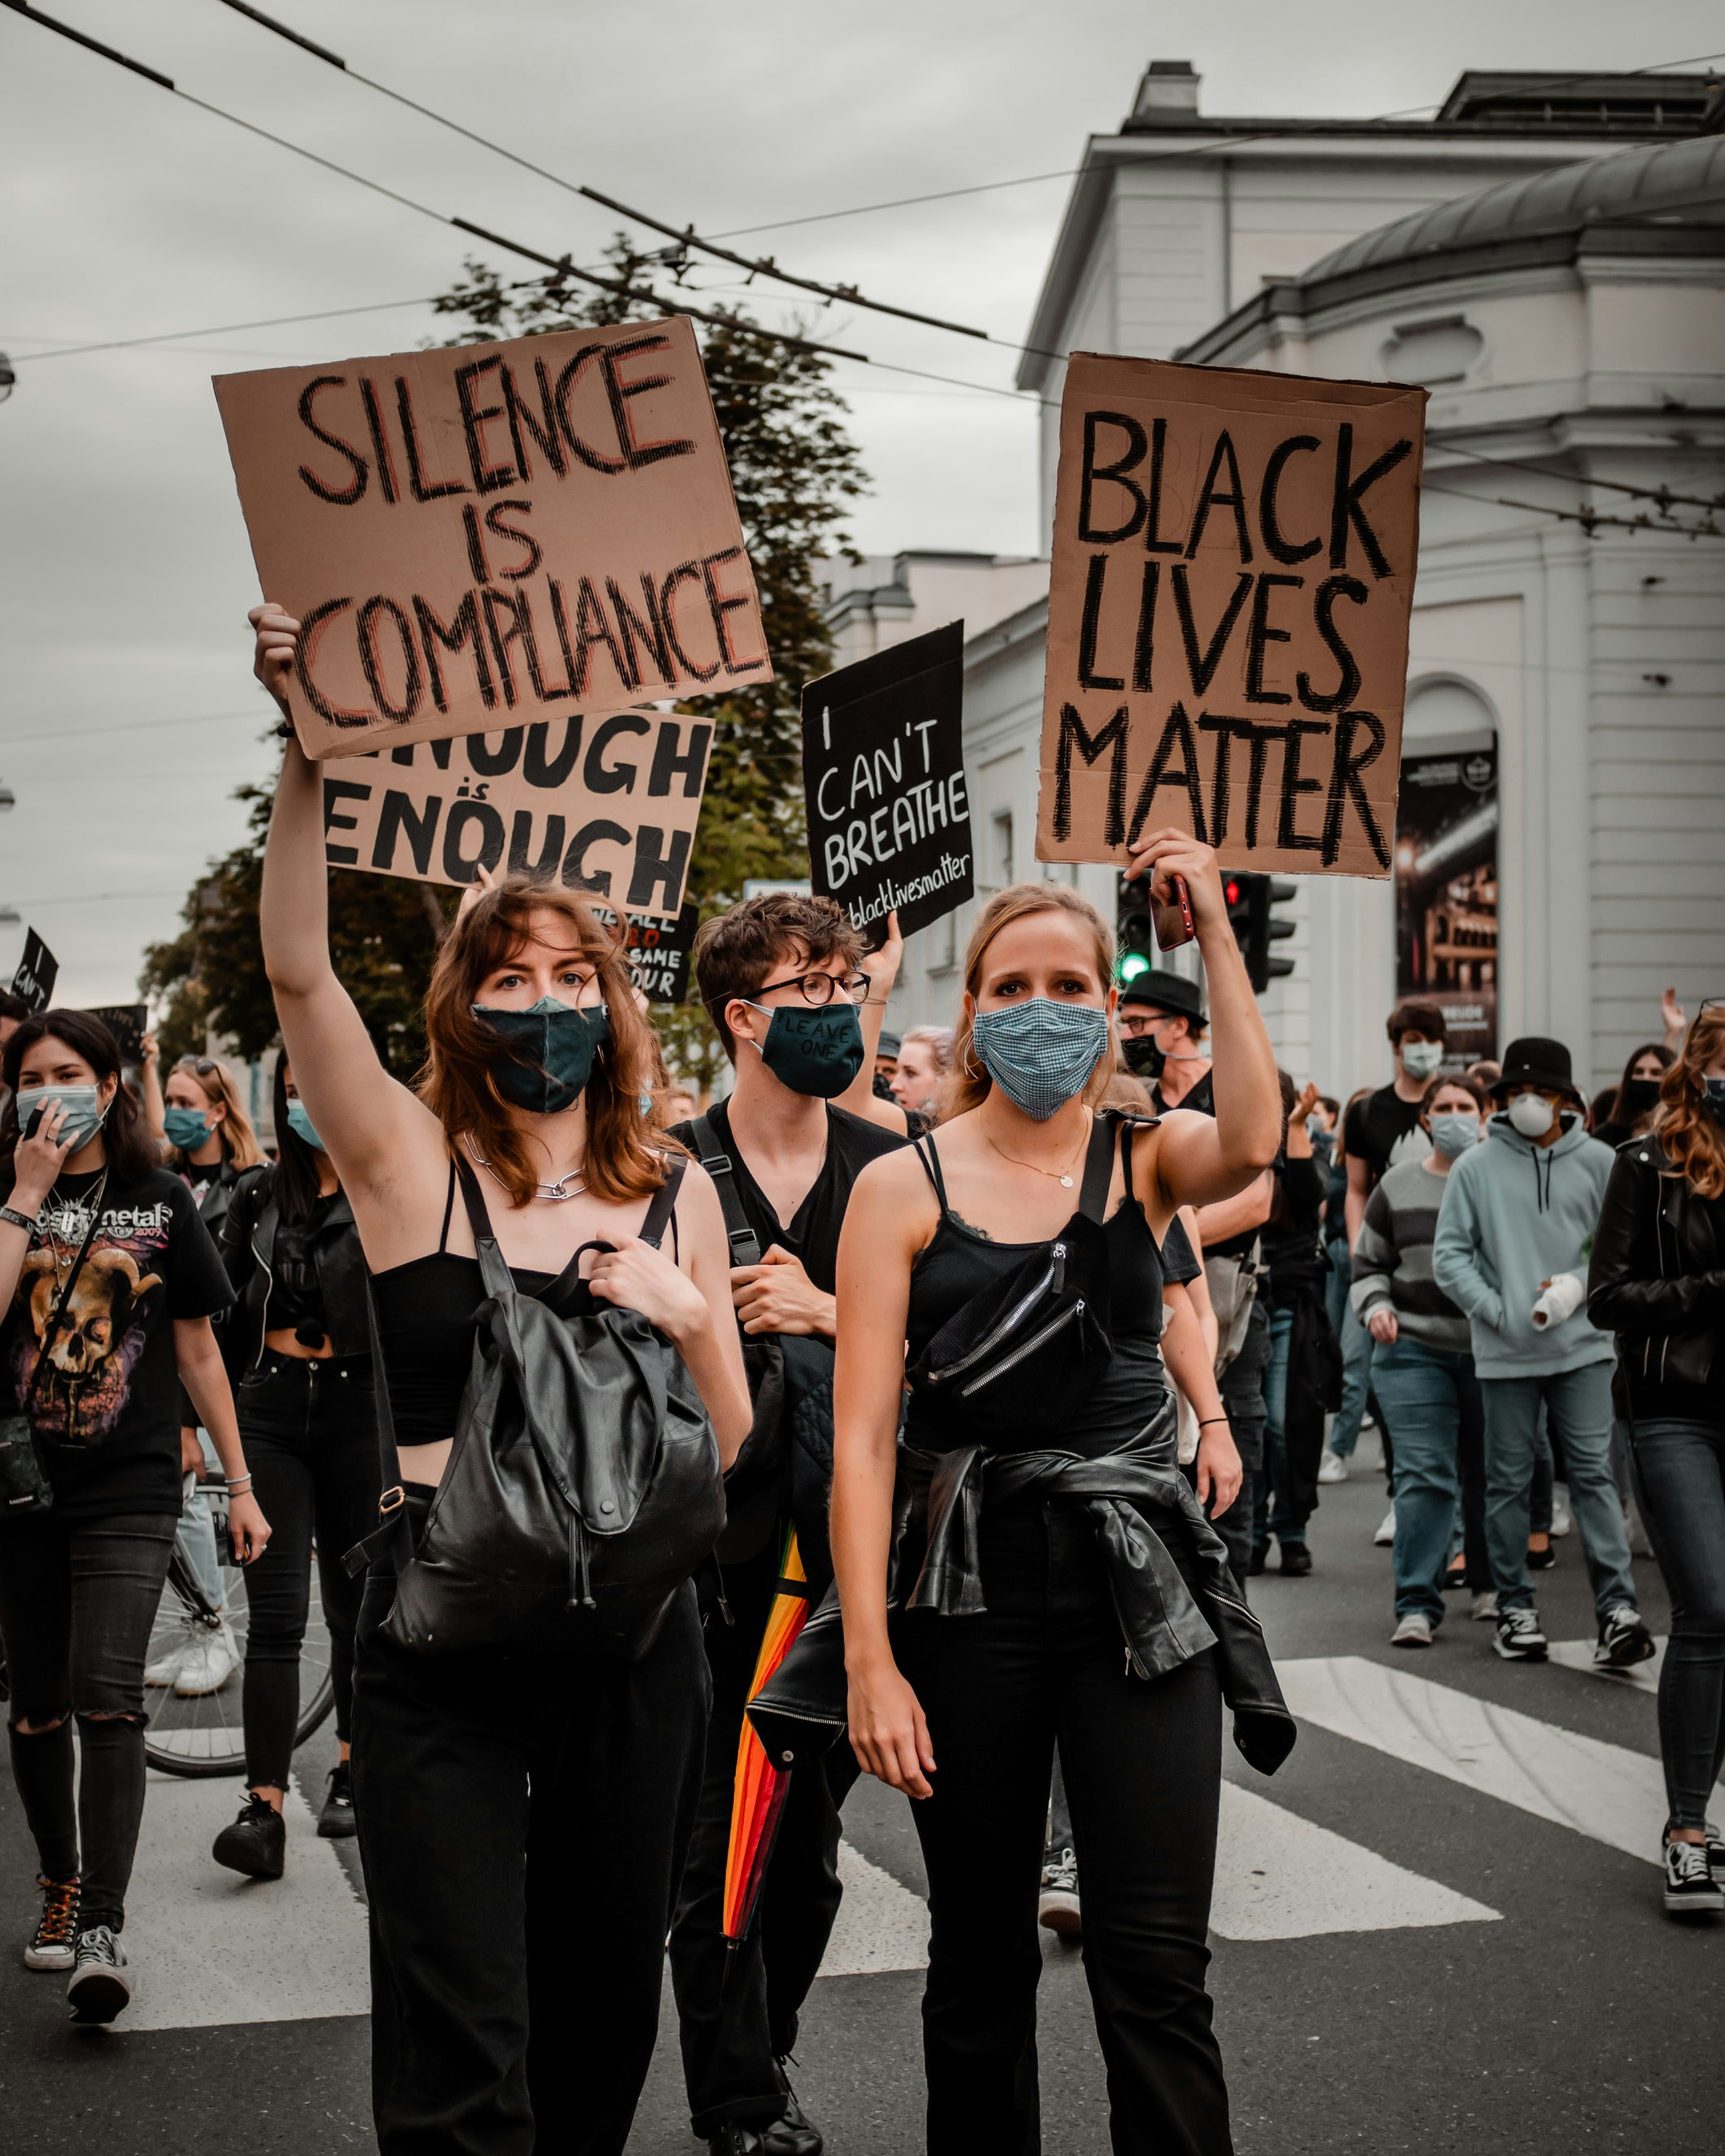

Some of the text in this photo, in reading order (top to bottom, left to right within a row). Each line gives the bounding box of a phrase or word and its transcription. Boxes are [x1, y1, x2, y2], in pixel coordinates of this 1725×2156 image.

[298, 334, 698, 505] SILENCE
[461, 499, 544, 585] IS
[1078, 411, 1413, 579] BLACK
[295, 546, 766, 728] COMPLIANCE
[1077, 552, 1369, 714] LIVES
[817, 719, 938, 822] CAN'T
[822, 705, 831, 750] I
[456, 775, 491, 801] is
[824, 770, 970, 890] BREATHE
[1053, 700, 1392, 870] MATTER
[323, 777, 692, 912] ENOUGH
[629, 947, 683, 969] SAME
[784, 1016, 853, 1044] LEAVE
[801, 1039, 840, 1061] ONE
[134, 1227, 162, 1236] 2009
